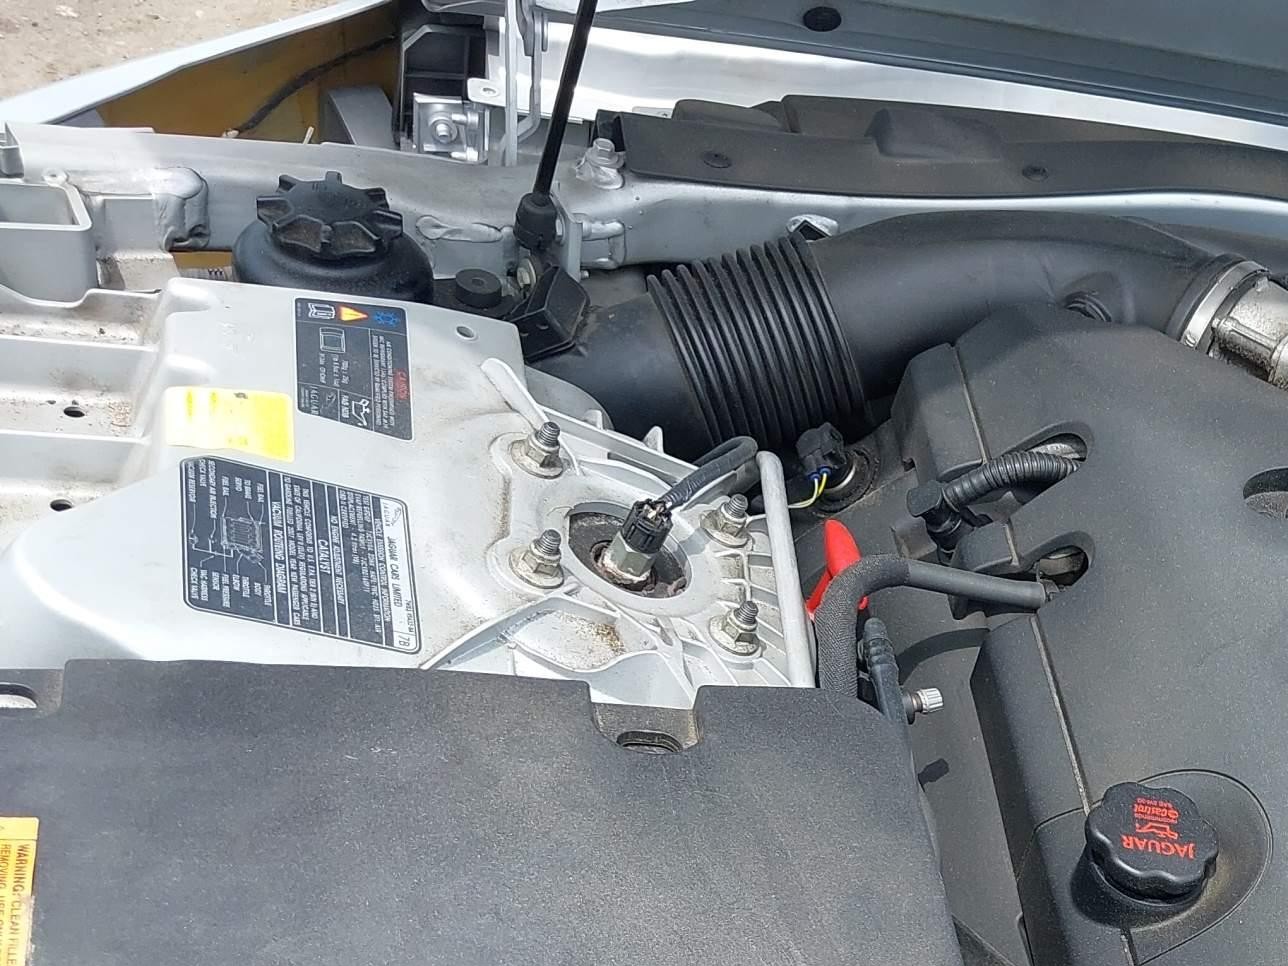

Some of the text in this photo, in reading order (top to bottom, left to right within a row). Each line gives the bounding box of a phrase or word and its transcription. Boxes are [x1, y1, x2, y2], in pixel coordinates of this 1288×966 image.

[271, 500, 282, 527] VACUUM
[330, 514, 338, 524] NO
[317, 538, 330, 574] CATALYST
[387, 536, 403, 607] JAGUAR CARS LIMITED
[274, 562, 286, 594] DIAGRAM
[1133, 803, 1168, 817] Castrol
[1121, 834, 1196, 859] JAGUAR
[12, 844, 31, 897] WARNING:
[8, 900, 22, 935] CLEAN
